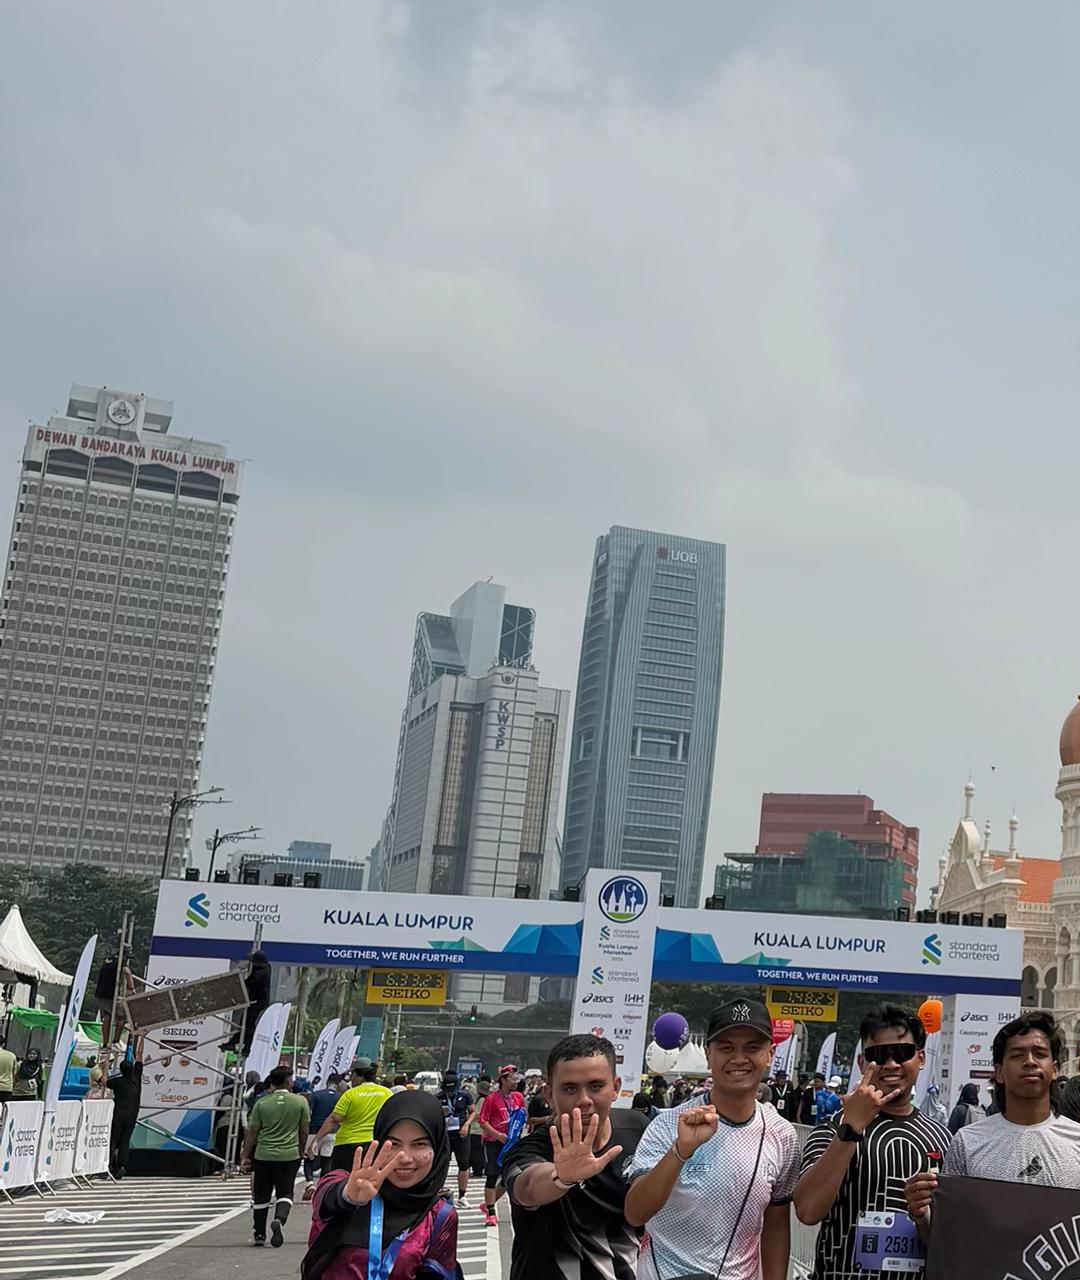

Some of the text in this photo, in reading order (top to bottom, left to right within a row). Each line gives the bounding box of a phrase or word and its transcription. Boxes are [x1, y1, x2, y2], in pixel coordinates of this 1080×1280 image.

[36, 428, 236, 474] DEWAN BANDARAYA KUALA LUMPUR
[671, 549, 698, 564] UOB
[495, 701, 510, 749] KWSP
[220, 901, 279, 914] standard
[218, 911, 281, 924] chartered
[324, 909, 474, 931] KUALA LUMPUR
[754, 932, 886, 953] KUALA LUMPUR
[949, 940, 998, 952] standard
[326, 949, 464, 964] TOGETHER, WE RUN FURTHER
[948, 950, 1000, 962] chartered
[757, 969, 879, 984] TOGETHER, WE RUN FURTHER
[382, 989, 431, 1000] SEIKO
[781, 1005, 824, 1016] SEIKO
[162, 1028, 199, 1037] SEIKO
